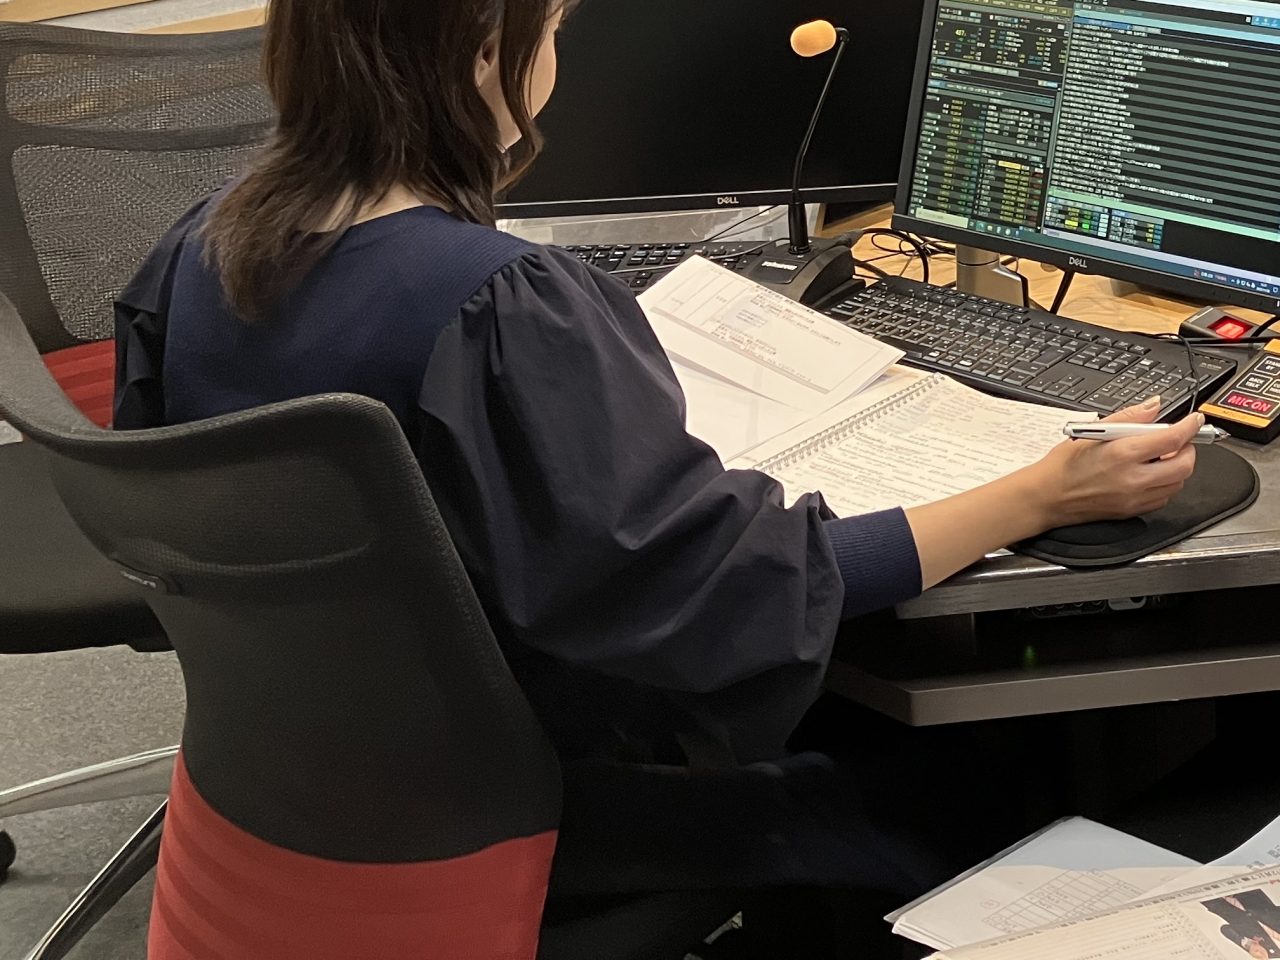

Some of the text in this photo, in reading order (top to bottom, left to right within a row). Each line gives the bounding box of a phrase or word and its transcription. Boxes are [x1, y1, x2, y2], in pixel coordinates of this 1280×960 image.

[716, 196, 740, 205] DELL
[1068, 256, 1088, 268] DELL
[1228, 394, 1272, 412] MIC ON
